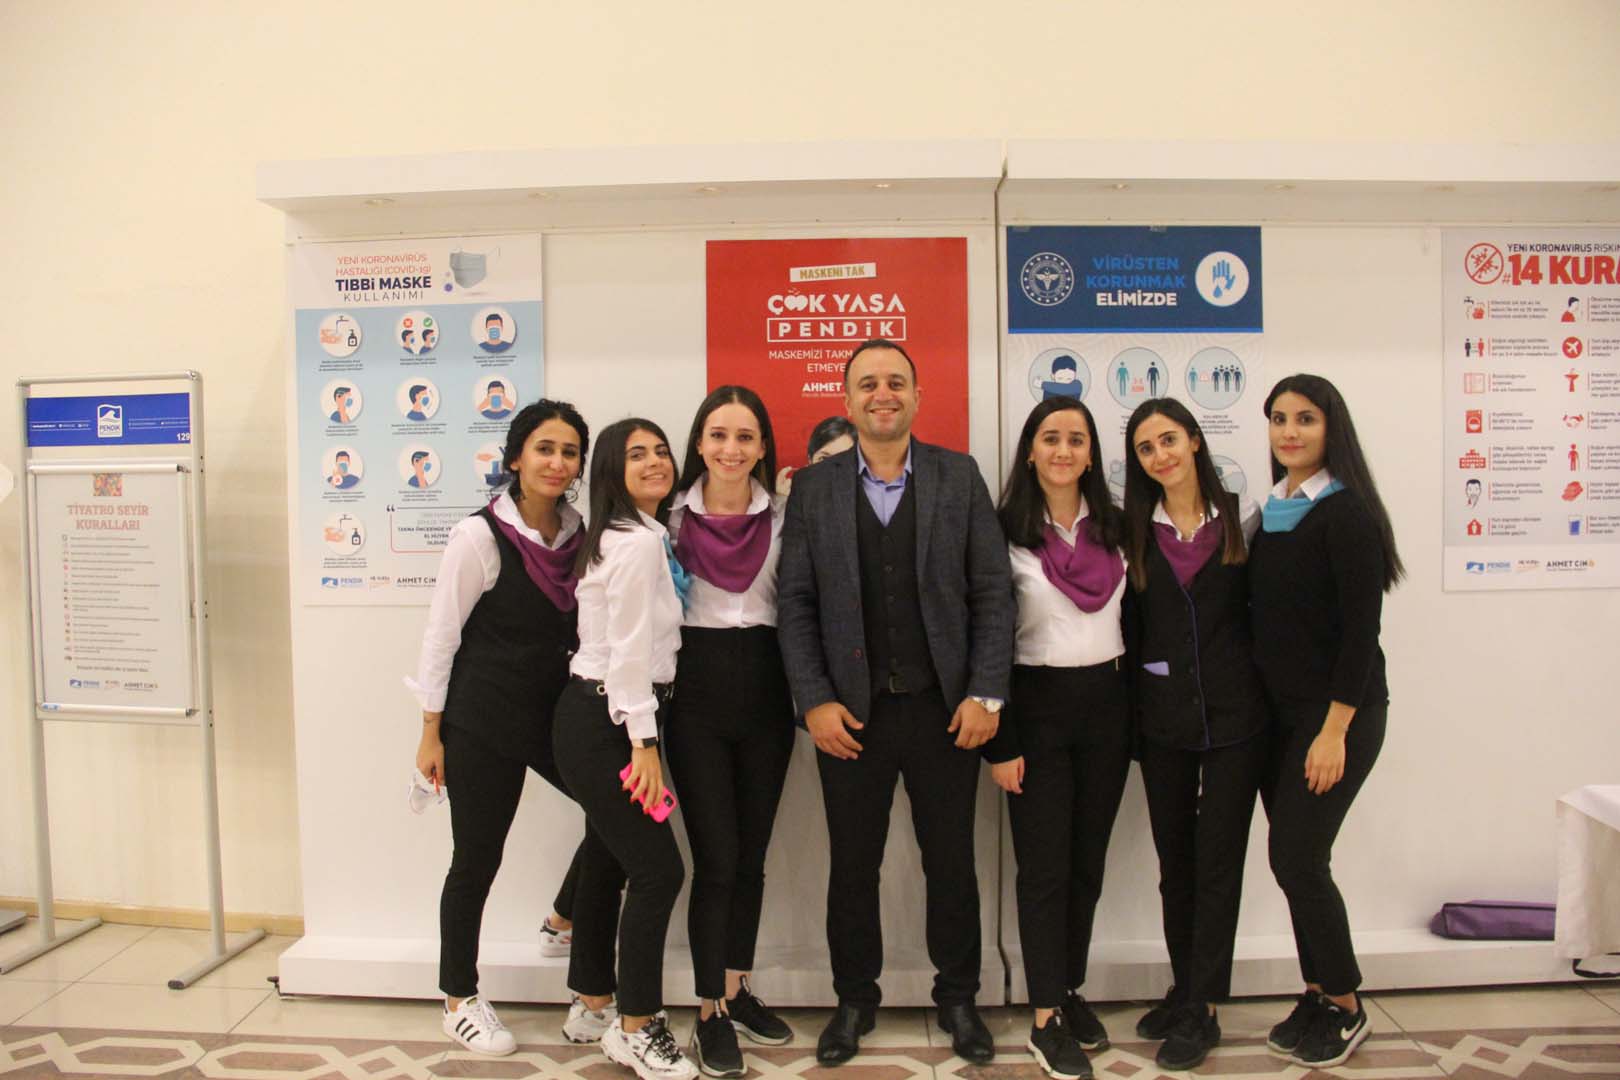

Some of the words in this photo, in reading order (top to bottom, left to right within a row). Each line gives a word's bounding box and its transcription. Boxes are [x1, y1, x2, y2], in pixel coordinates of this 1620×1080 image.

[845, 265, 865, 277] TAK
[1549, 255, 1620, 285] KUR
[379, 275, 432, 290] MASKE
[1086, 274, 1186, 289] KORUNMAK
[343, 290, 424, 303] KULLANIMI
[1096, 289, 1177, 306] ELİMİZDE
[802, 382, 842, 392] AHMET
[176, 432, 191, 441] 129
[75, 519, 140, 530] KURALLARI
